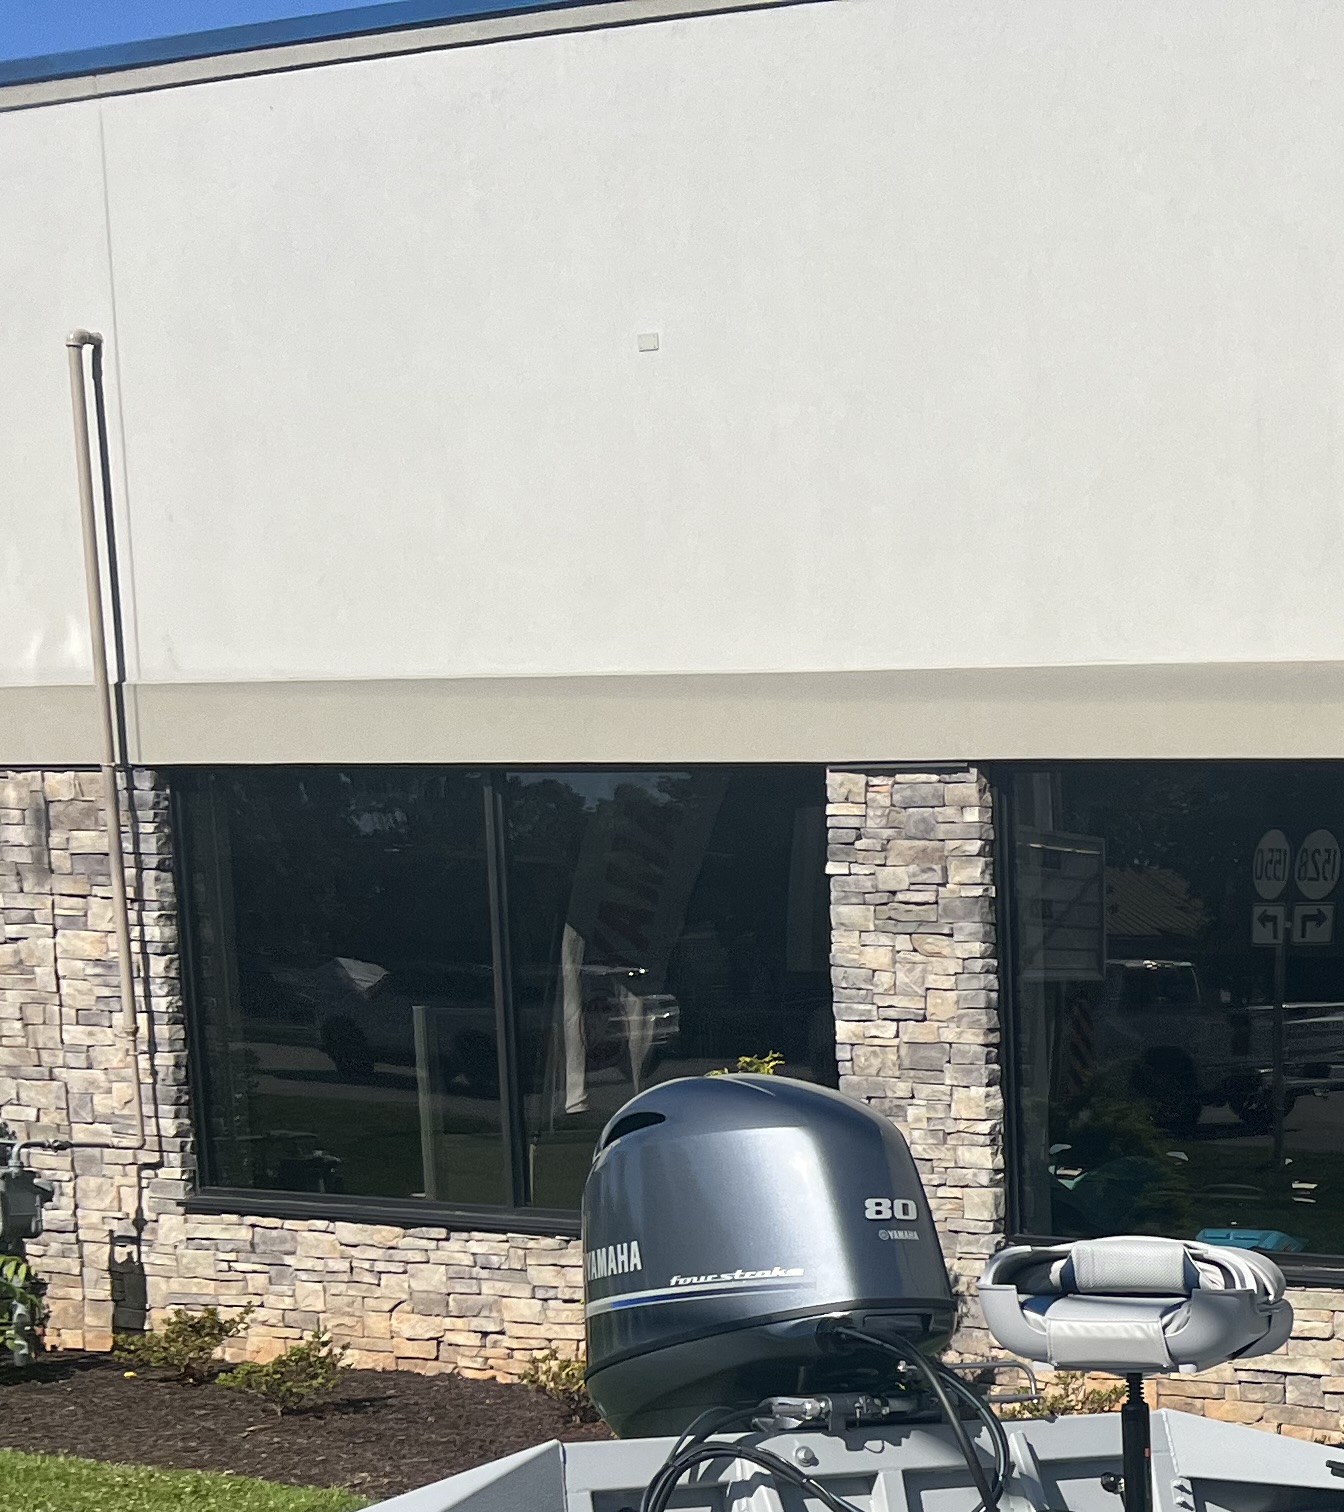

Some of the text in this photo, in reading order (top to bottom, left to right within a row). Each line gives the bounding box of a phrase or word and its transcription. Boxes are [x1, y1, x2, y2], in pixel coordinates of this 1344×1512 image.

[864, 1197, 918, 1221] 80
[888, 1229, 920, 1241] YAMAHA
[586, 1240, 643, 1282] YAMAHA
